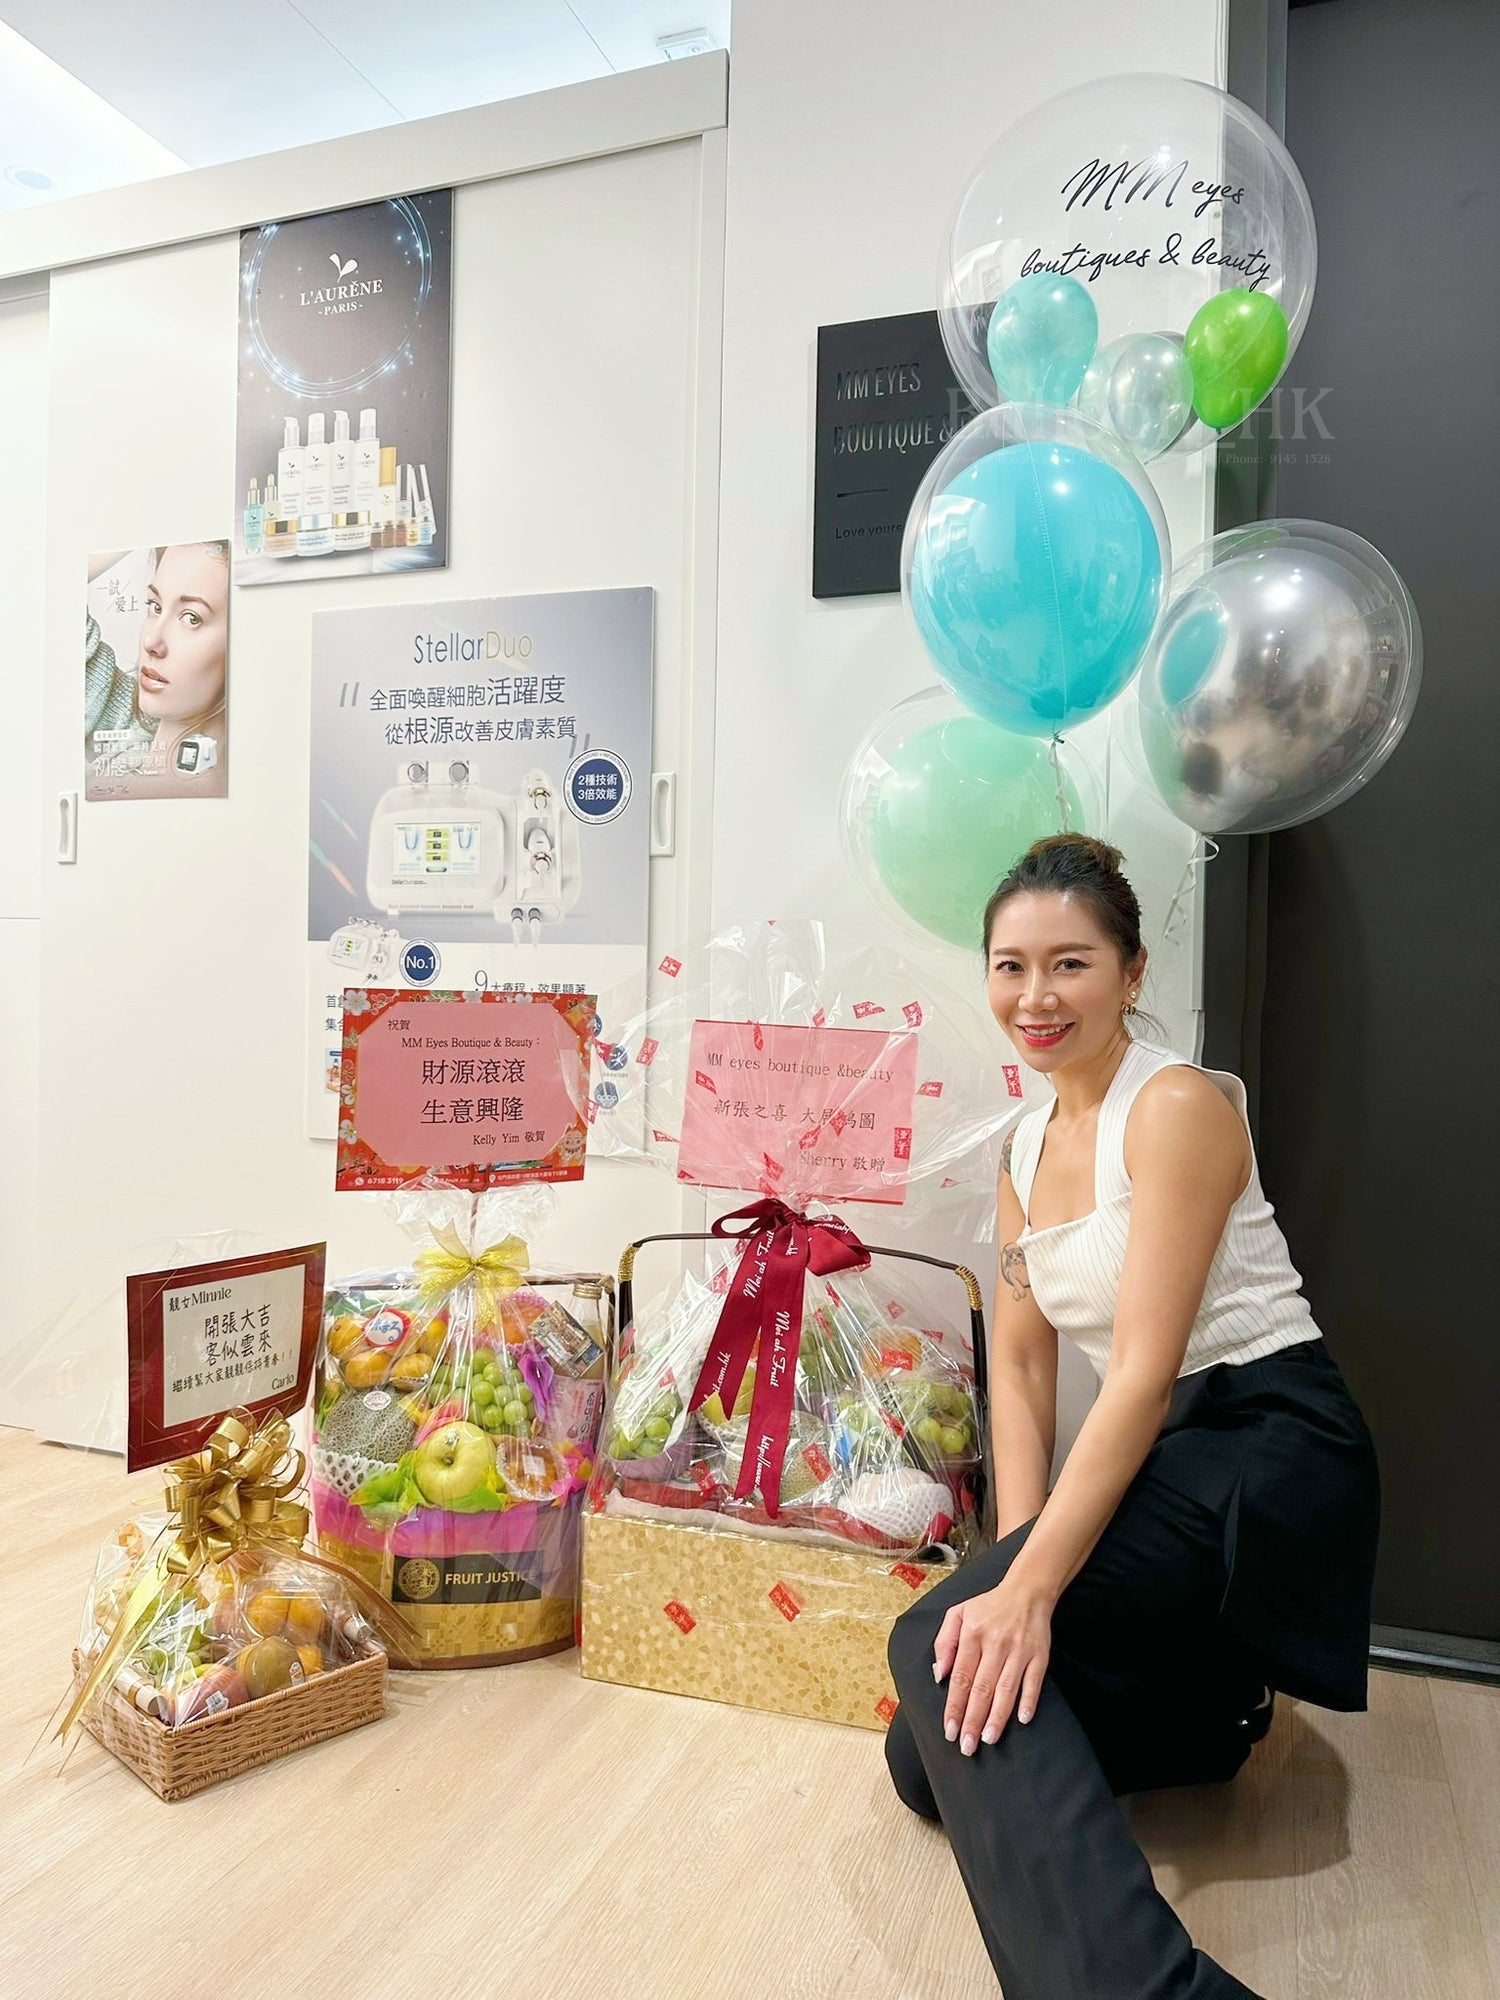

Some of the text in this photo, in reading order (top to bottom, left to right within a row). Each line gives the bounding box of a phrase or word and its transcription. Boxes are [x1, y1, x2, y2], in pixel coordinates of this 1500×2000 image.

[1191, 178, 1245, 218] eyes
[1020, 232, 1272, 293] boutiques & beauty
[836, 362, 922, 401] MM EYES
[833, 416, 935, 455] BOUTIQUE
[835, 526, 866, 540] Love
[114, 596, 139, 614] 愛上
[413, 630, 534, 665] StellarDuo
[369, 675, 566, 712] 全面喚醒細胞活躍度
[384, 715, 577, 745] 從根源改善皮膚素質
[577, 787, 618, 801] 3倍效能
[405, 955, 436, 970] No.1
[387, 1018, 411, 1032] 祝賀
[401, 1036, 423, 1049] MM
[425, 1036, 449, 1050] Eyes
[451, 1036, 492, 1051] Boutique
[493, 1037, 502, 1049] &
[421, 1058, 526, 1085] 財源滾滾
[707, 1052, 724, 1068] MM
[729, 1058, 761, 1071] eyes
[767, 1058, 831, 1078] boutique
[419, 1097, 525, 1125] 生意興隆
[713, 1099, 788, 1123] 新張之喜
[473, 1130, 546, 1147] Kelly Yim 敬賀
[742, 1275, 763, 1300] Mei
[757, 1260, 768, 1276] ah
[204, 1303, 271, 1339] 開張大吉
[205, 1329, 272, 1367] 客似雲來
[769, 1310, 791, 1388] Mei ah Fruit
[711, 1351, 731, 1394] it.com.hk
[444, 1571, 484, 1586] FRUIT
